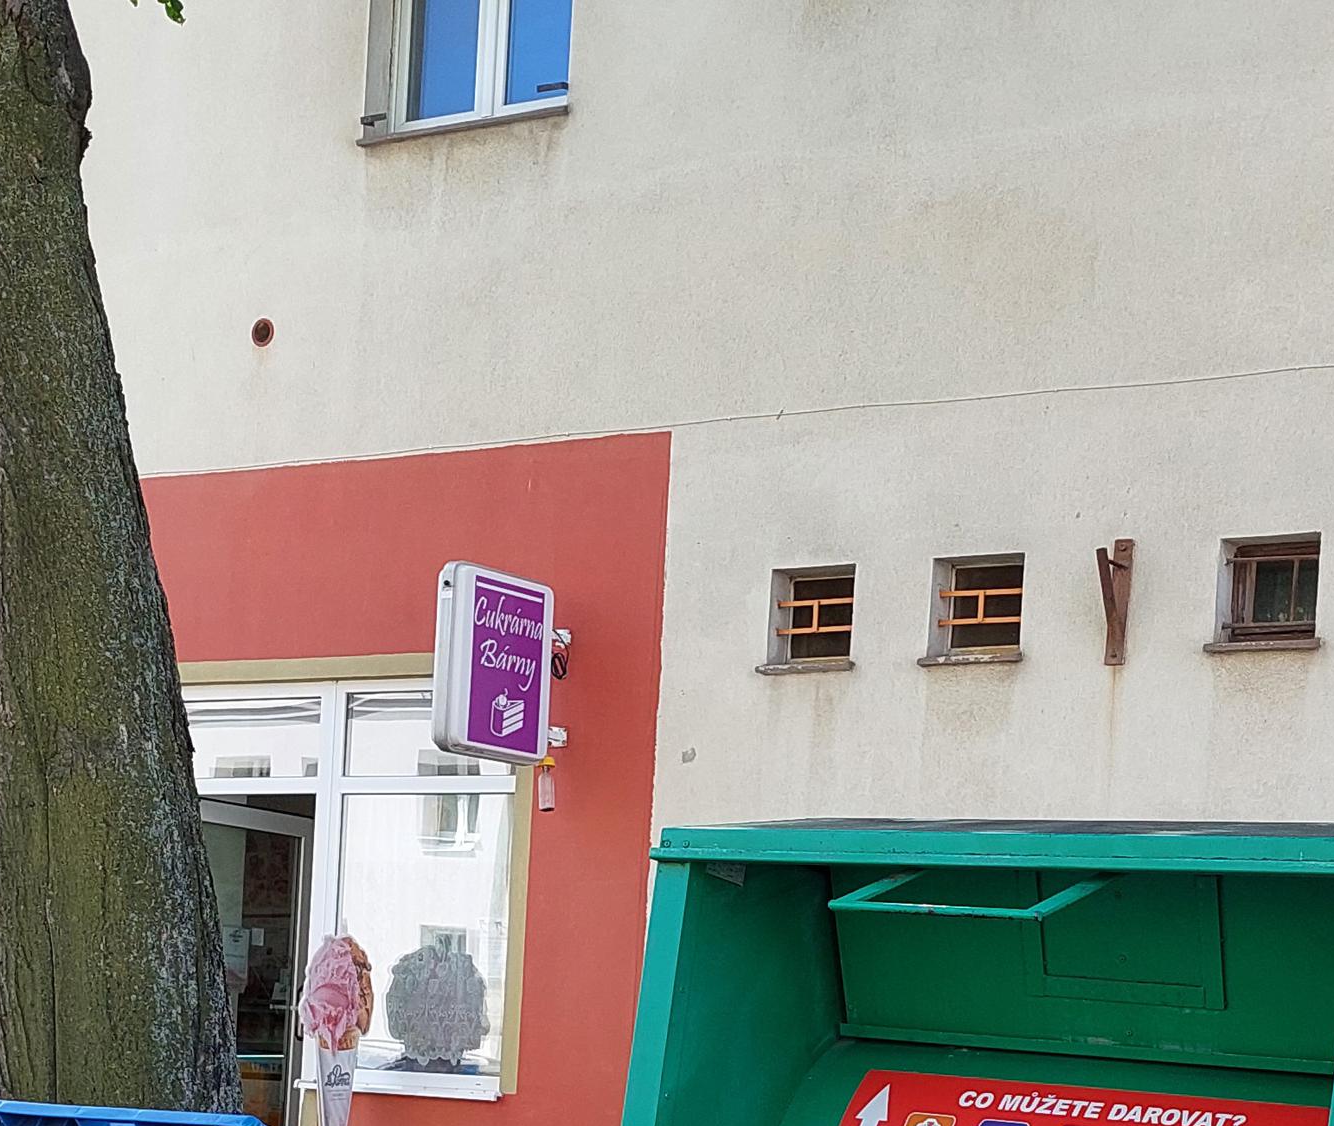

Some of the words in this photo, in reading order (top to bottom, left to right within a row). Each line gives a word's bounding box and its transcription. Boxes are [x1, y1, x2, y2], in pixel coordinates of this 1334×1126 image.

[474, 595, 544, 640] Cukrárna
[480, 637, 537, 692] Bárny
[958, 1090, 995, 1109] CO
[998, 1092, 1105, 1119] MŮŽETE
